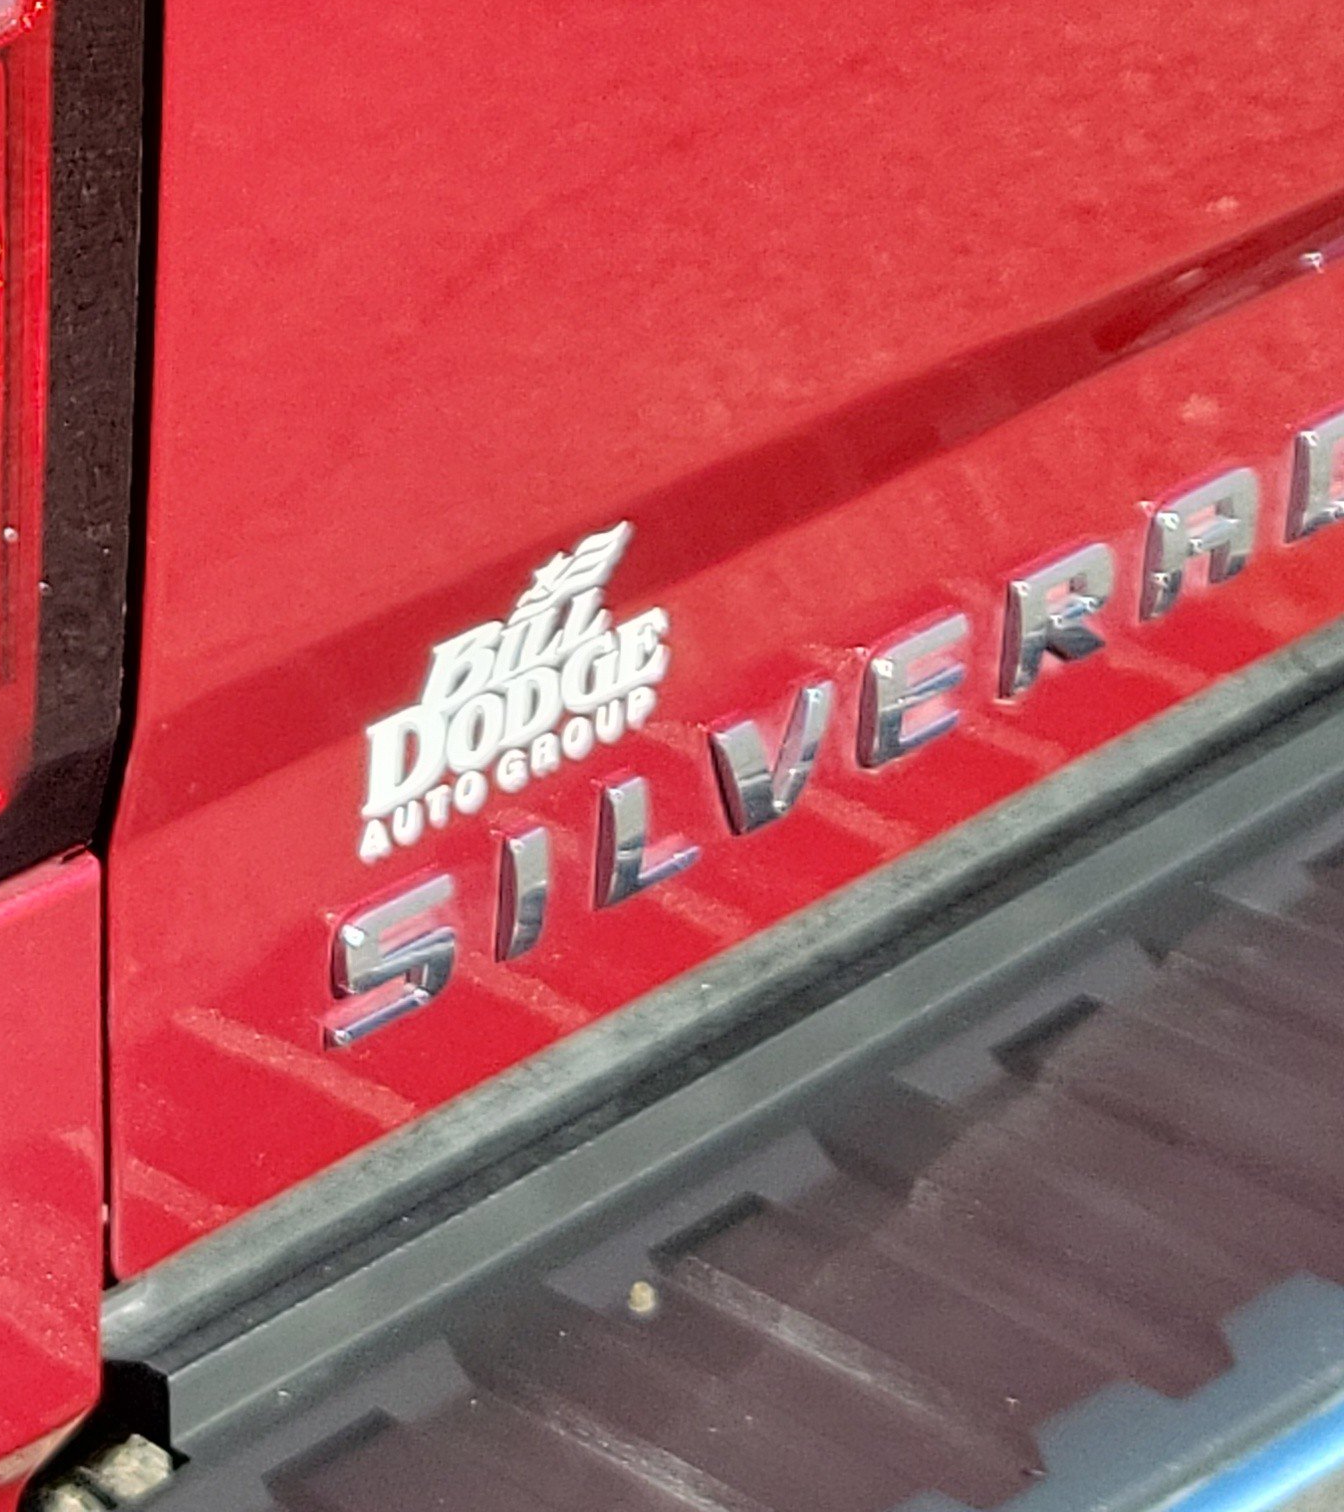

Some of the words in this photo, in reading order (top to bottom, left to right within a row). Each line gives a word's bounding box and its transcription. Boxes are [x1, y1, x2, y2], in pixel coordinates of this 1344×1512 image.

[361, 607, 669, 818] DODGE
[423, 586, 611, 705] BILL
[359, 770, 489, 863] AUTO
[497, 687, 656, 792] GROUP
